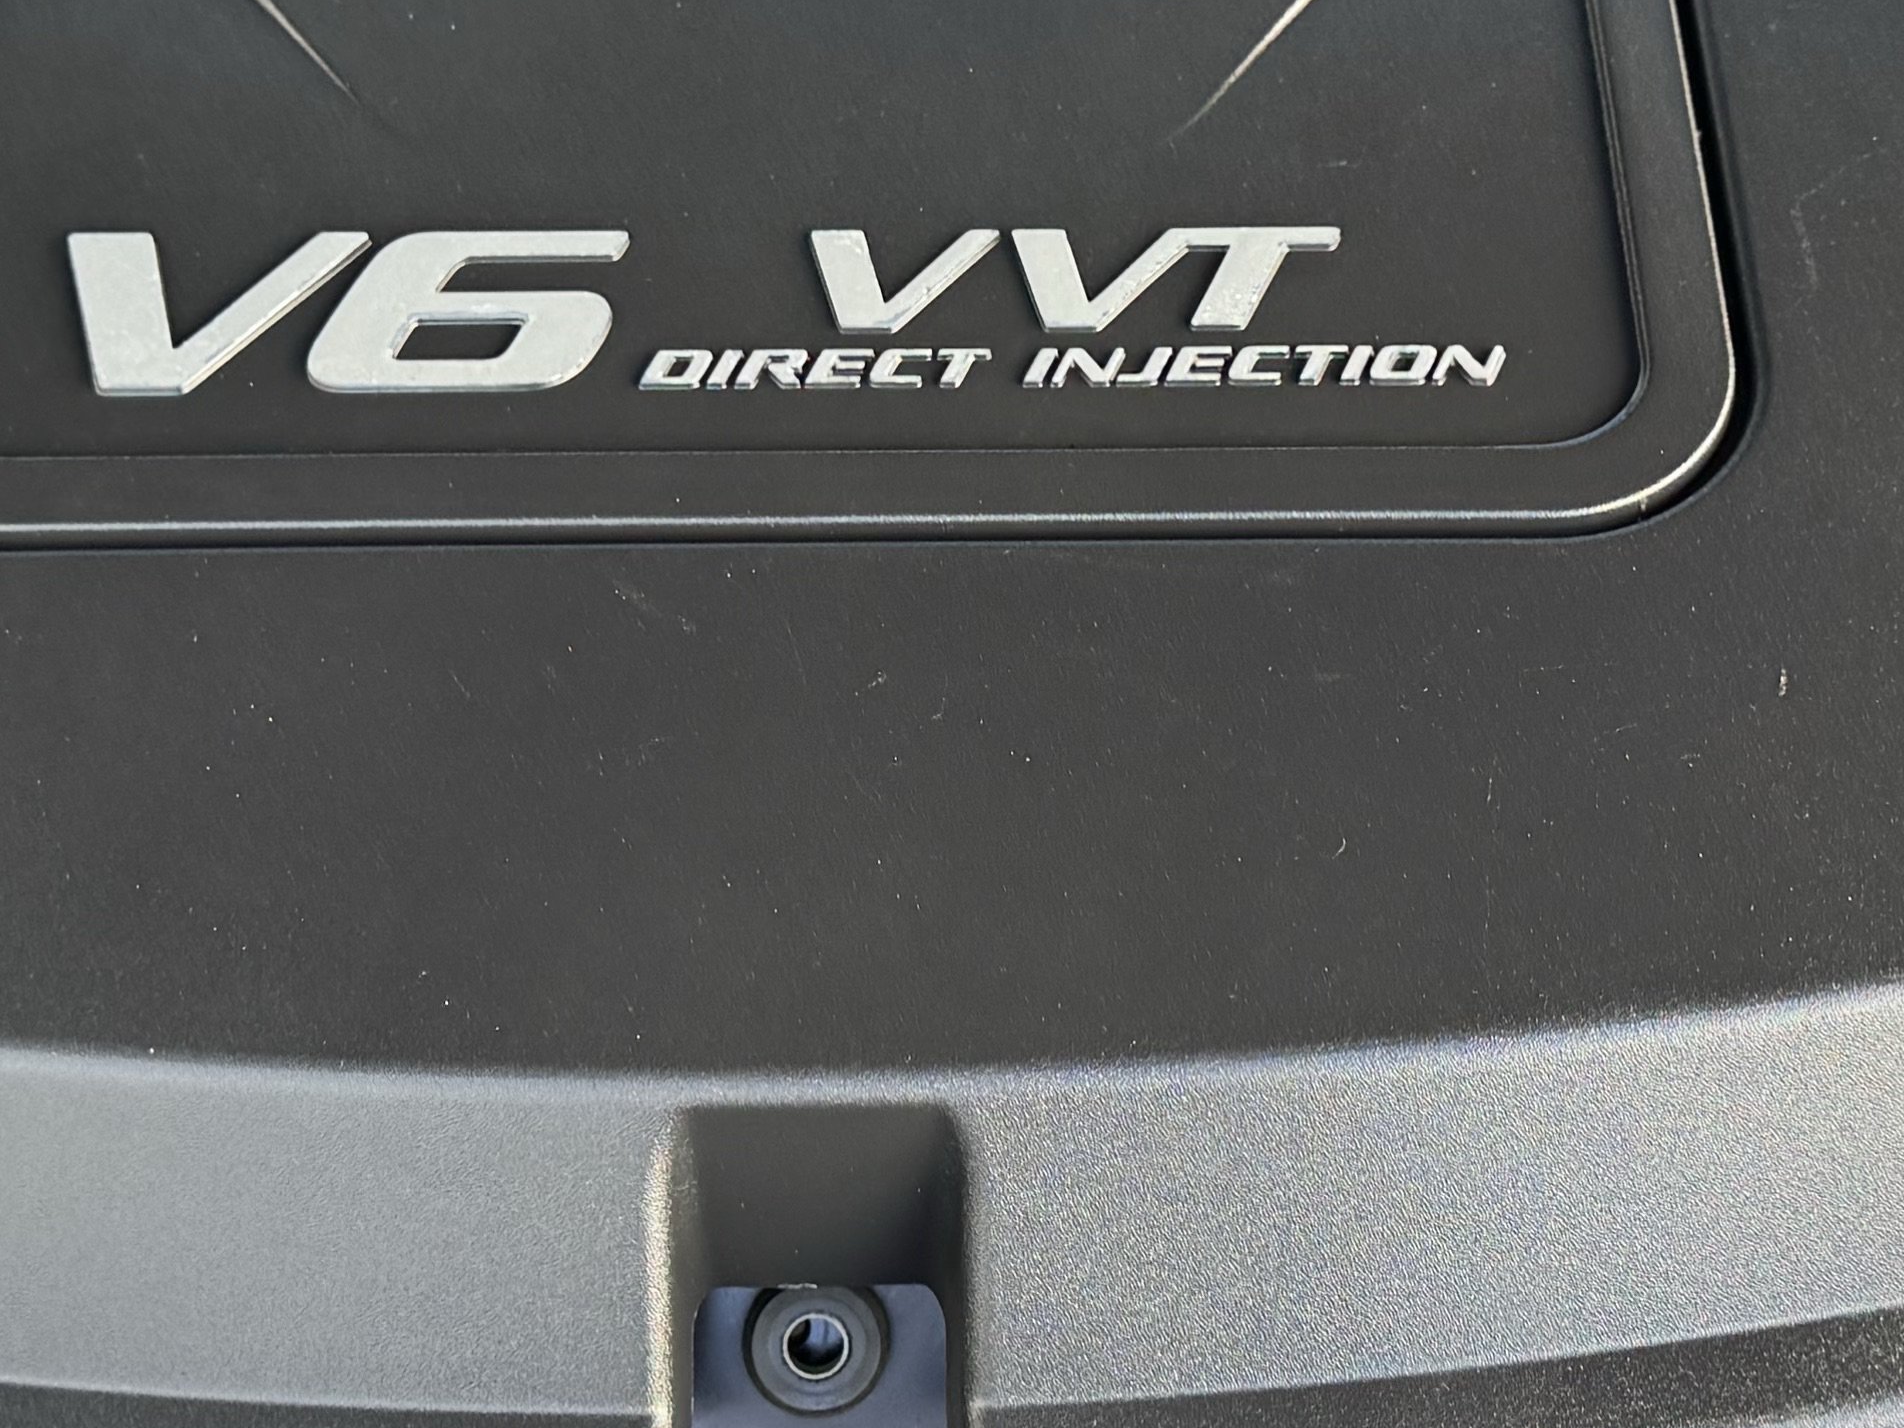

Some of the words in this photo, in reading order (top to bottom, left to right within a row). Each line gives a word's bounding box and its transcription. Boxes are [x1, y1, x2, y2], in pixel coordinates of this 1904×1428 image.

[67, 229, 631, 397] V6
[808, 226, 1343, 334] VVT
[637, 347, 993, 391] DIRECT
[1022, 343, 1508, 390] INJECTION
